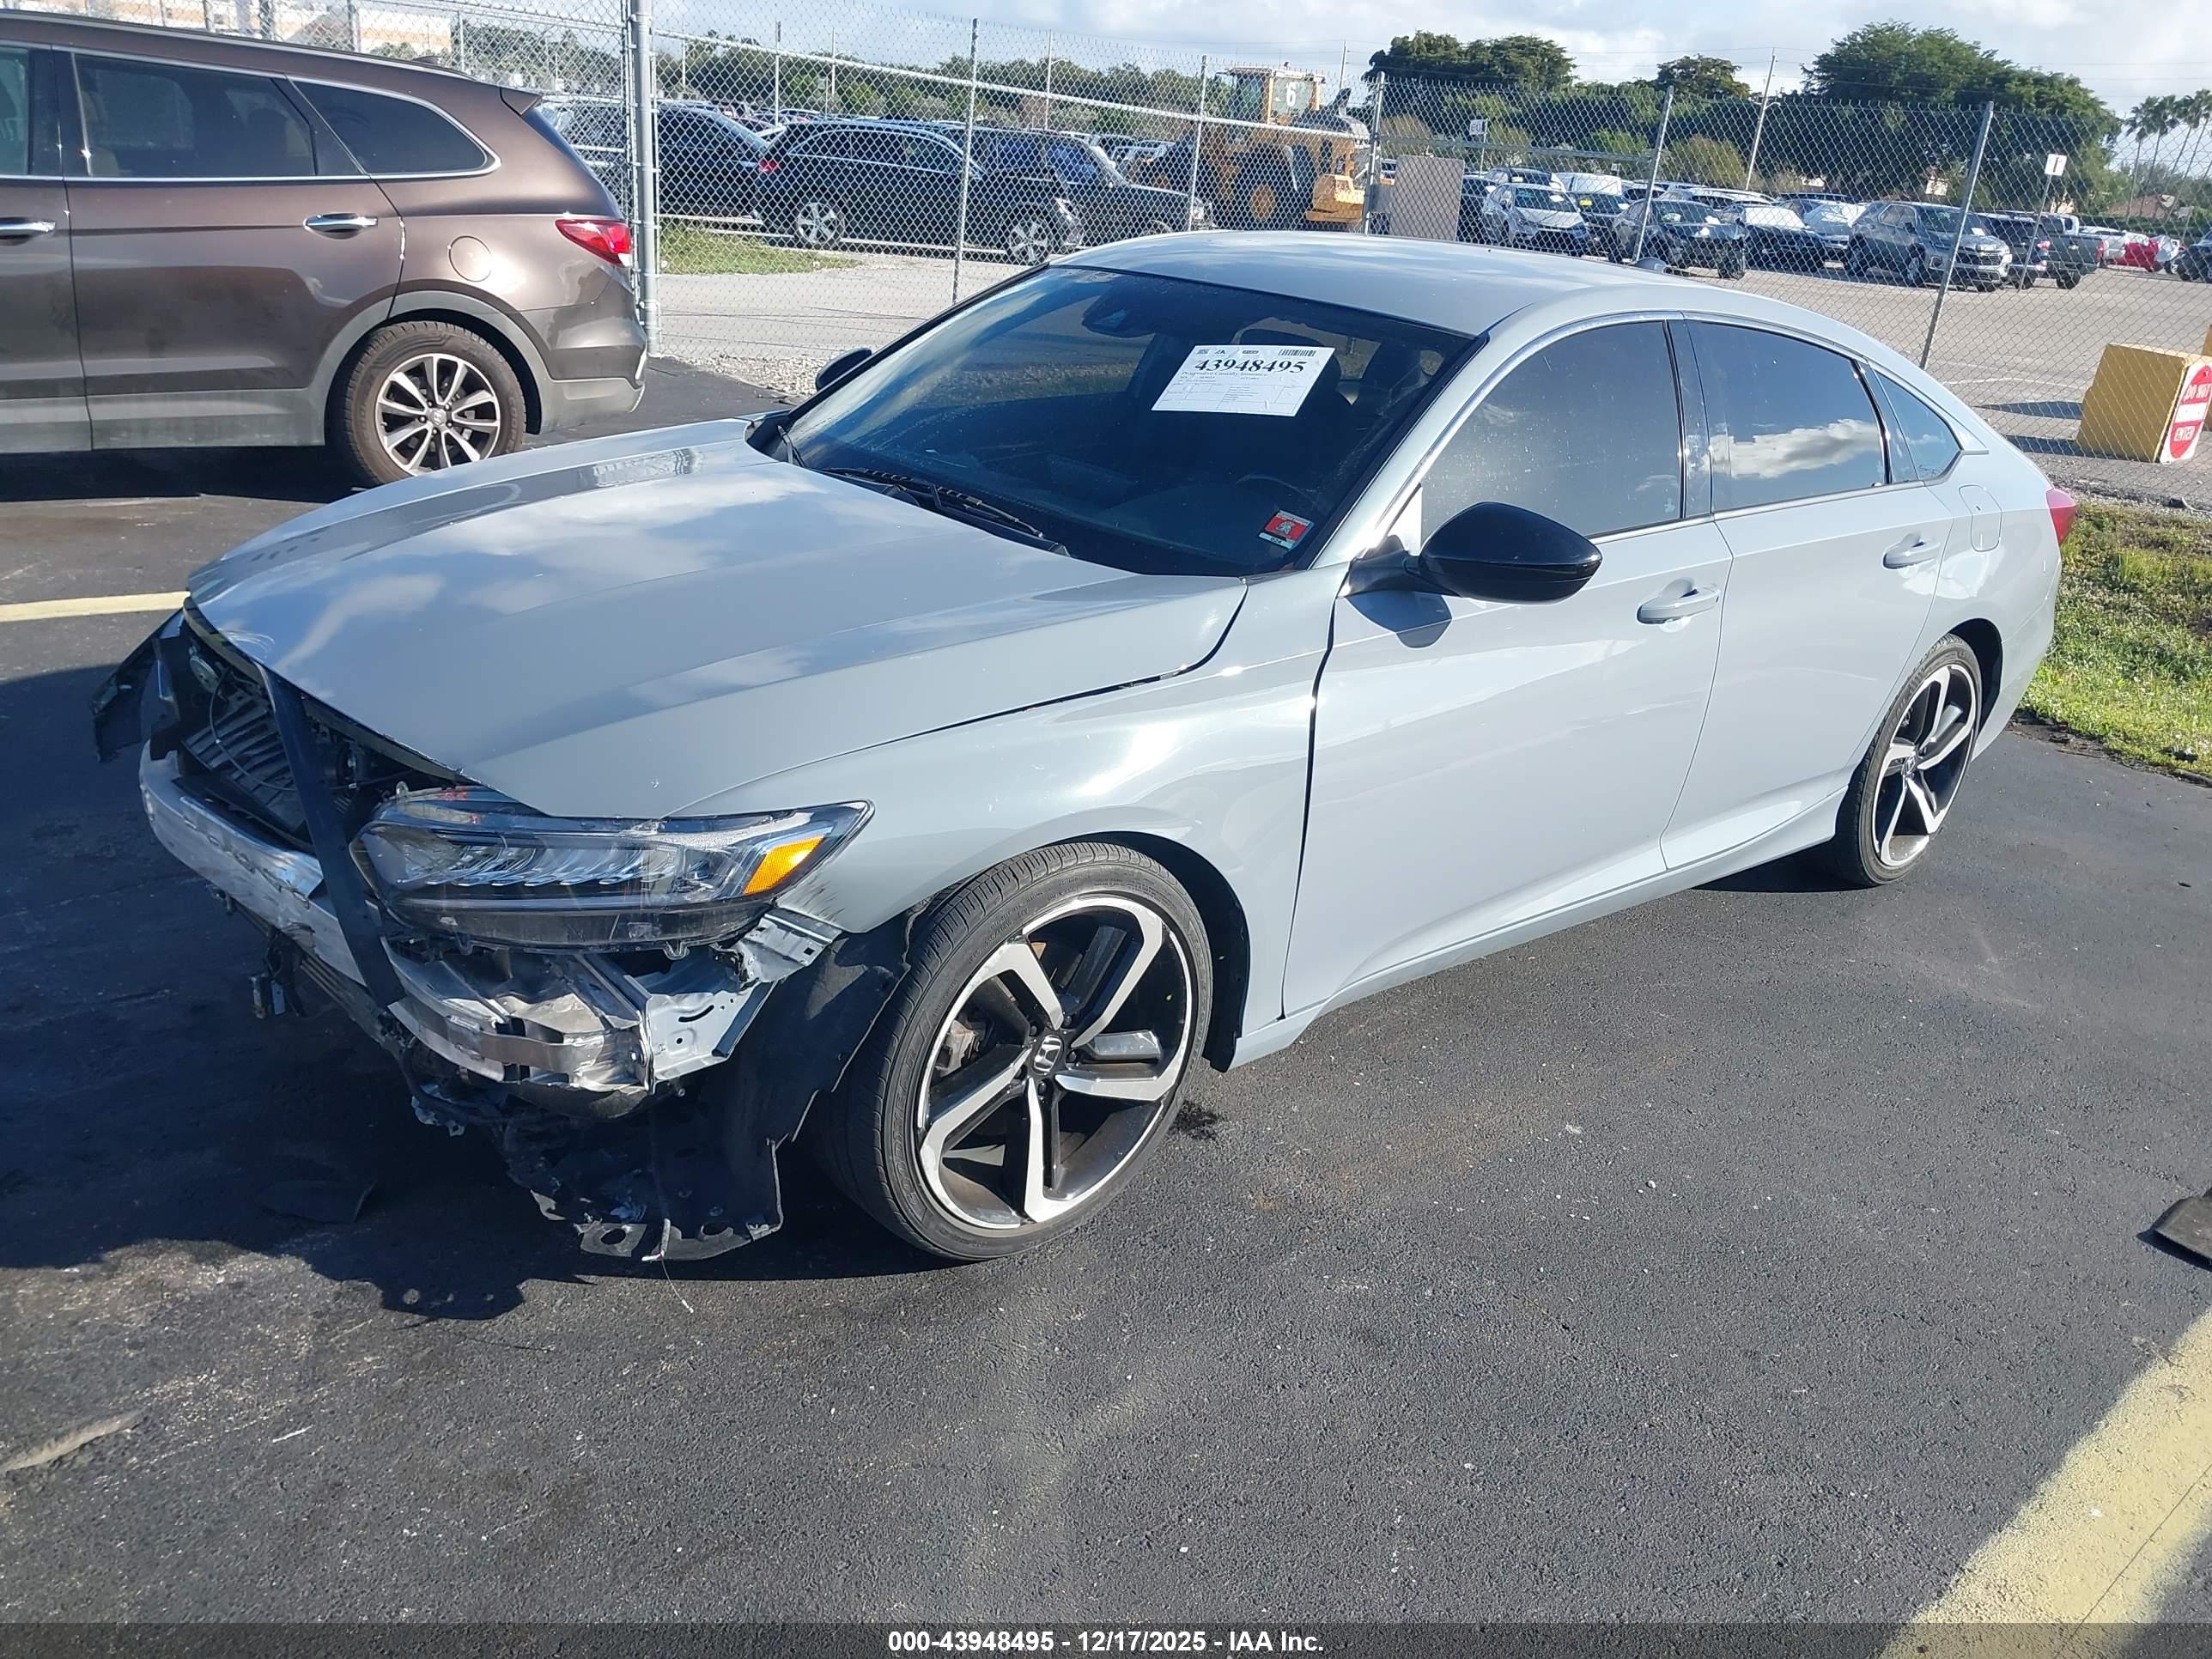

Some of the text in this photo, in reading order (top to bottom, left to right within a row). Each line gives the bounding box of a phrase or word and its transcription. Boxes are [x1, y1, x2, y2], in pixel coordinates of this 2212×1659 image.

[1286, 82, 1297, 107] 6
[1194, 359, 1308, 373] 43948495
[2184, 383, 2212, 401] DO NOT
[2173, 425, 2196, 441] ENTER
